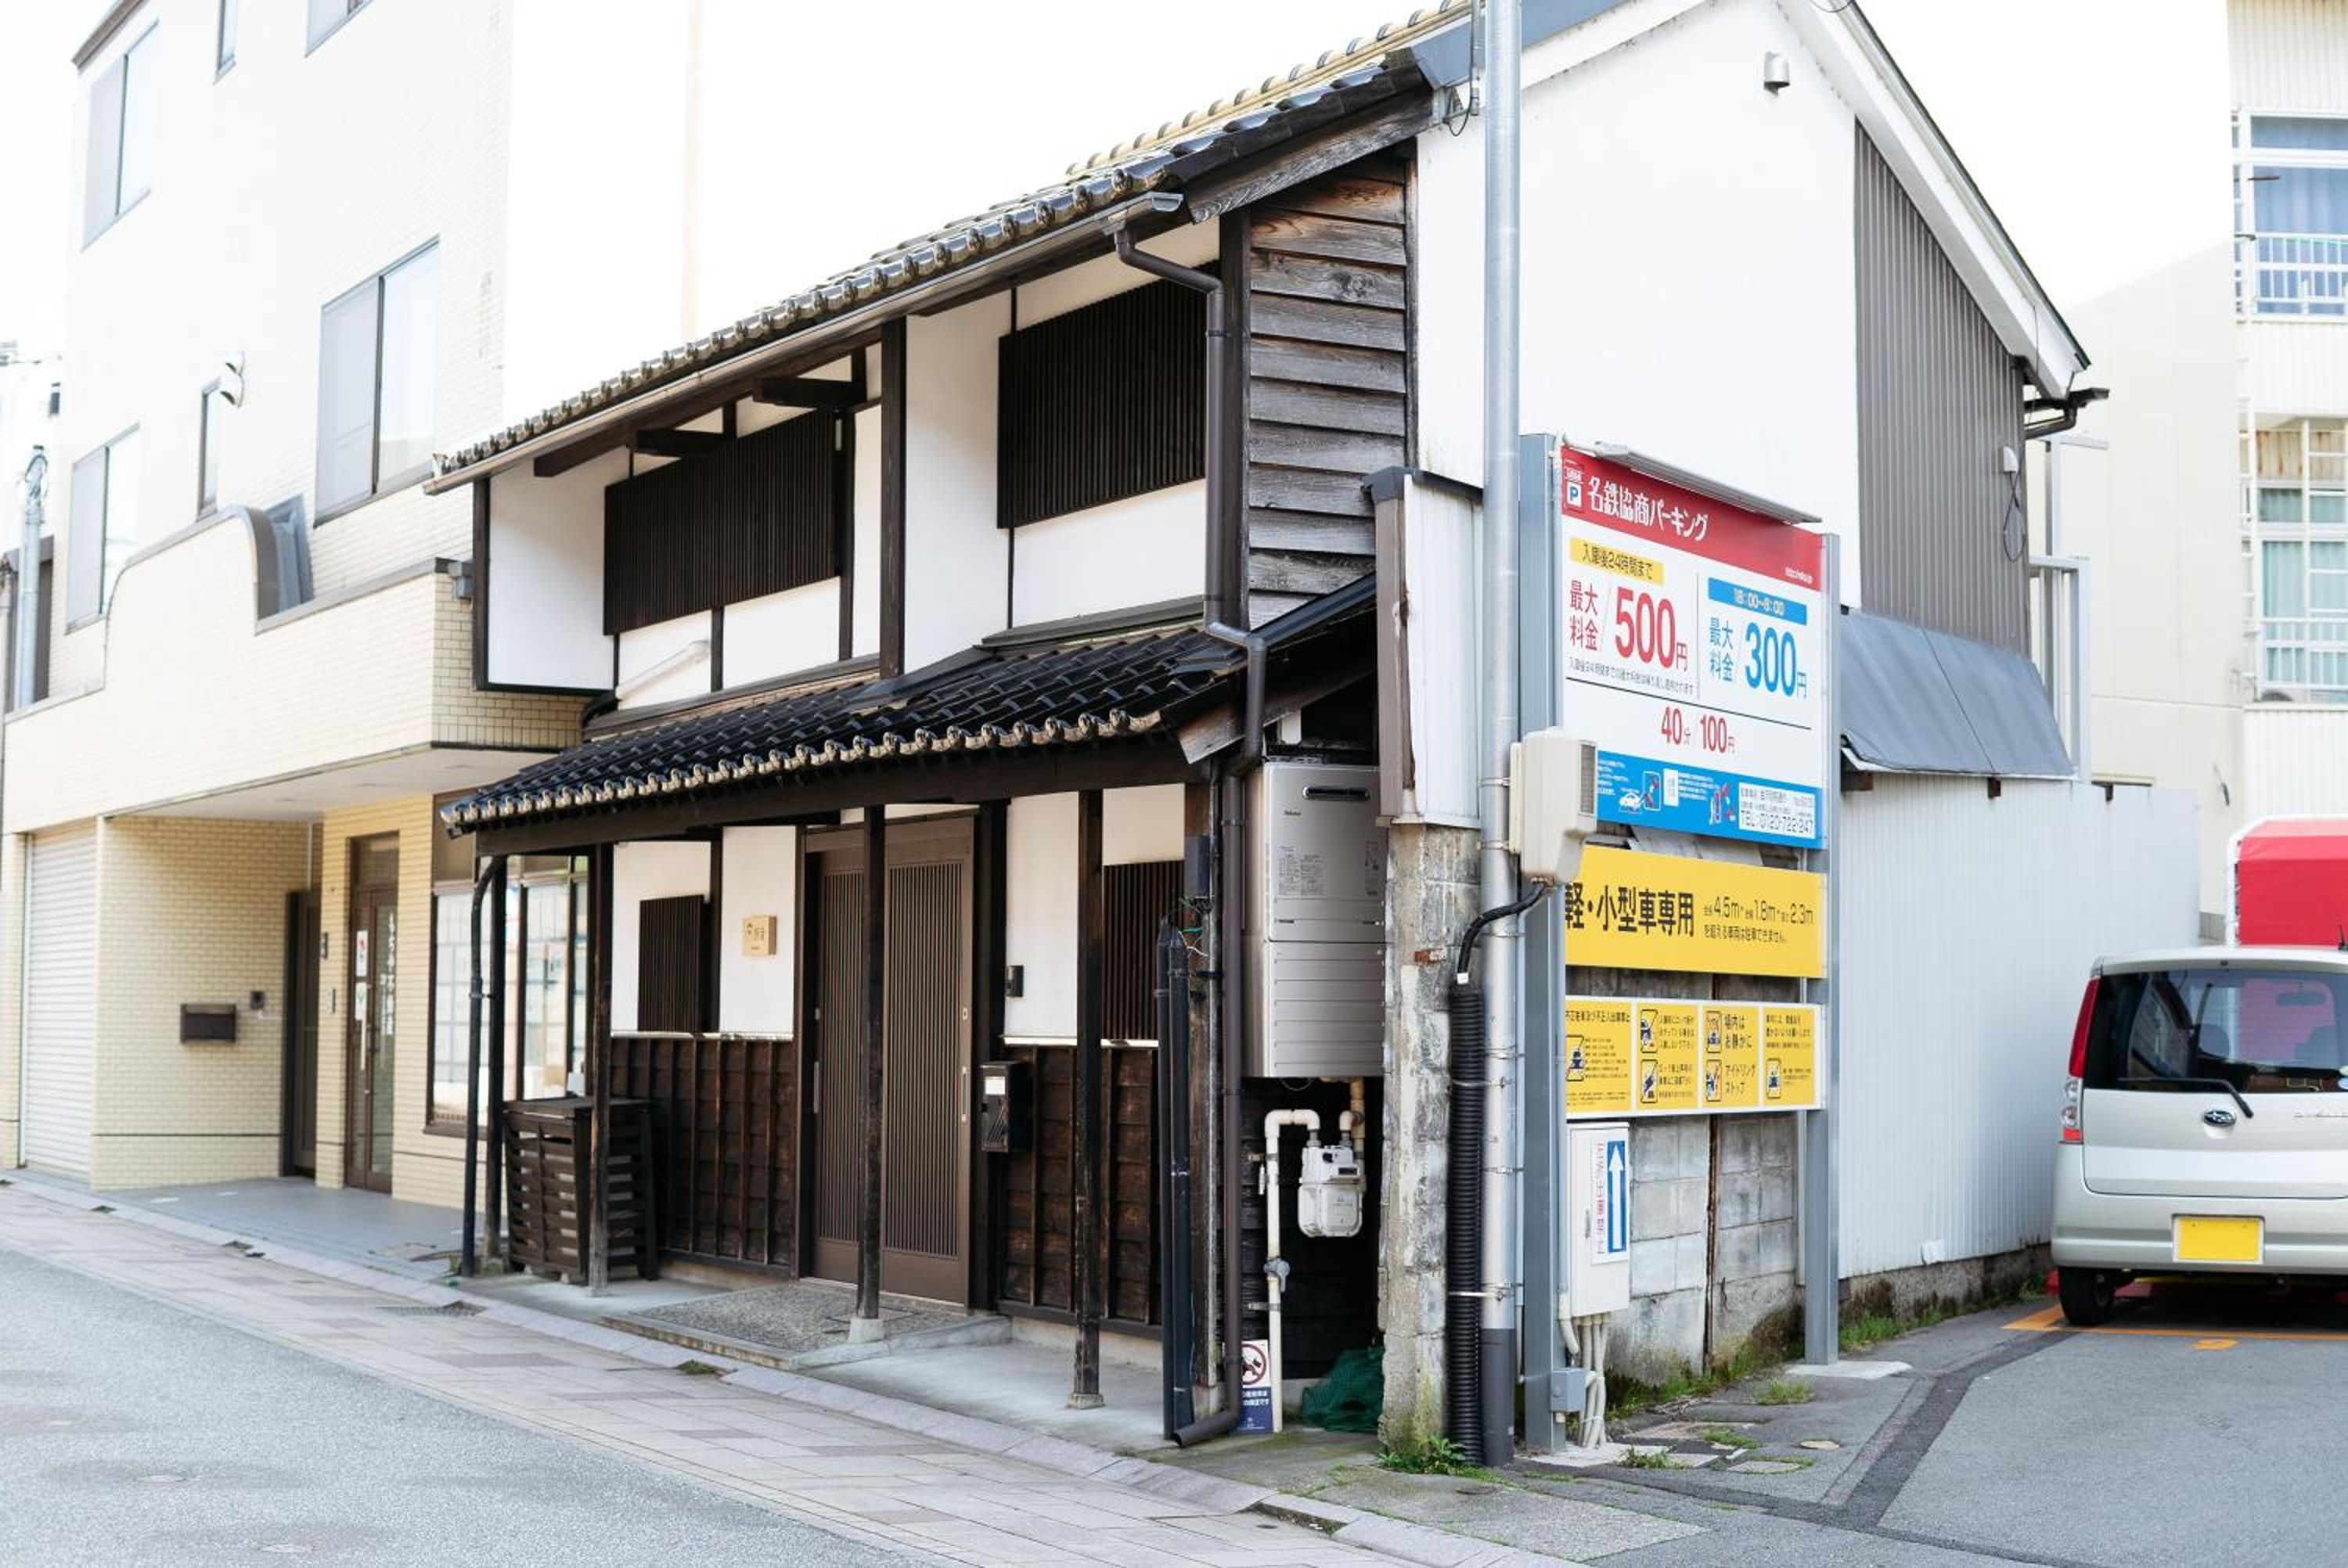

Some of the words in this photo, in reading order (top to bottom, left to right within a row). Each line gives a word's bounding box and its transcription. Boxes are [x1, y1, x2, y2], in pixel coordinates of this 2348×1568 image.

[1569, 486, 1579, 501] P
[1587, 476, 1709, 541] 名鉄協商パーキング
[1569, 580, 1599, 616] 最大
[1569, 614, 1599, 651] 料金
[1615, 586, 1688, 672] 500円
[1709, 617, 1734, 649] 最大
[1709, 649, 1734, 682] 料金
[1745, 622, 1807, 699] 300円
[1700, 714, 1735, 754] 100円
[1565, 882, 1694, 937] 軽・小型車専用
